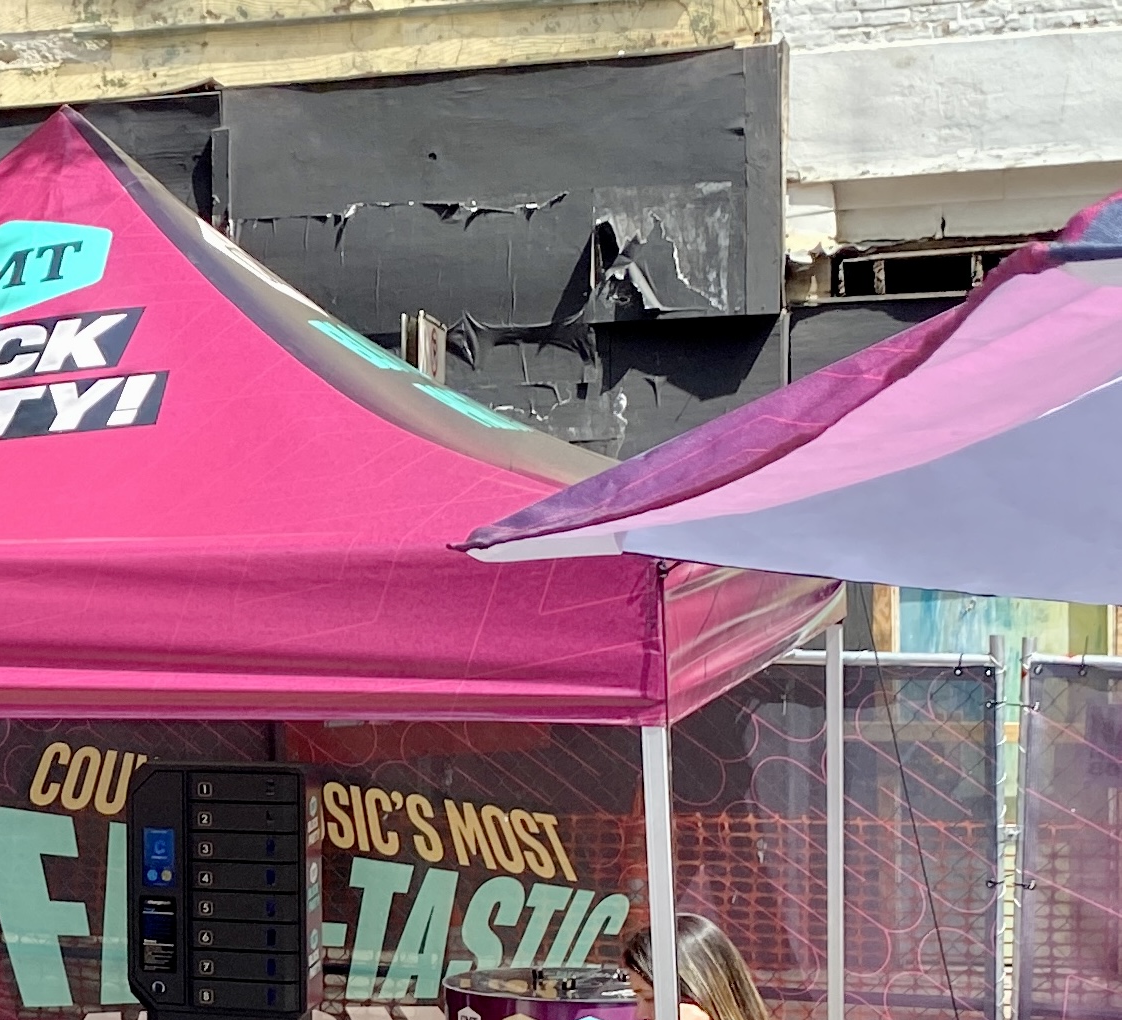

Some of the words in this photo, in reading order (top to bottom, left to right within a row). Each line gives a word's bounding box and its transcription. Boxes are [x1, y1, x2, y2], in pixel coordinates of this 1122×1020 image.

[29, 742, 148, 815] COU
[318, 782, 443, 862] SIC’S
[444, 799, 578, 881] MOST
